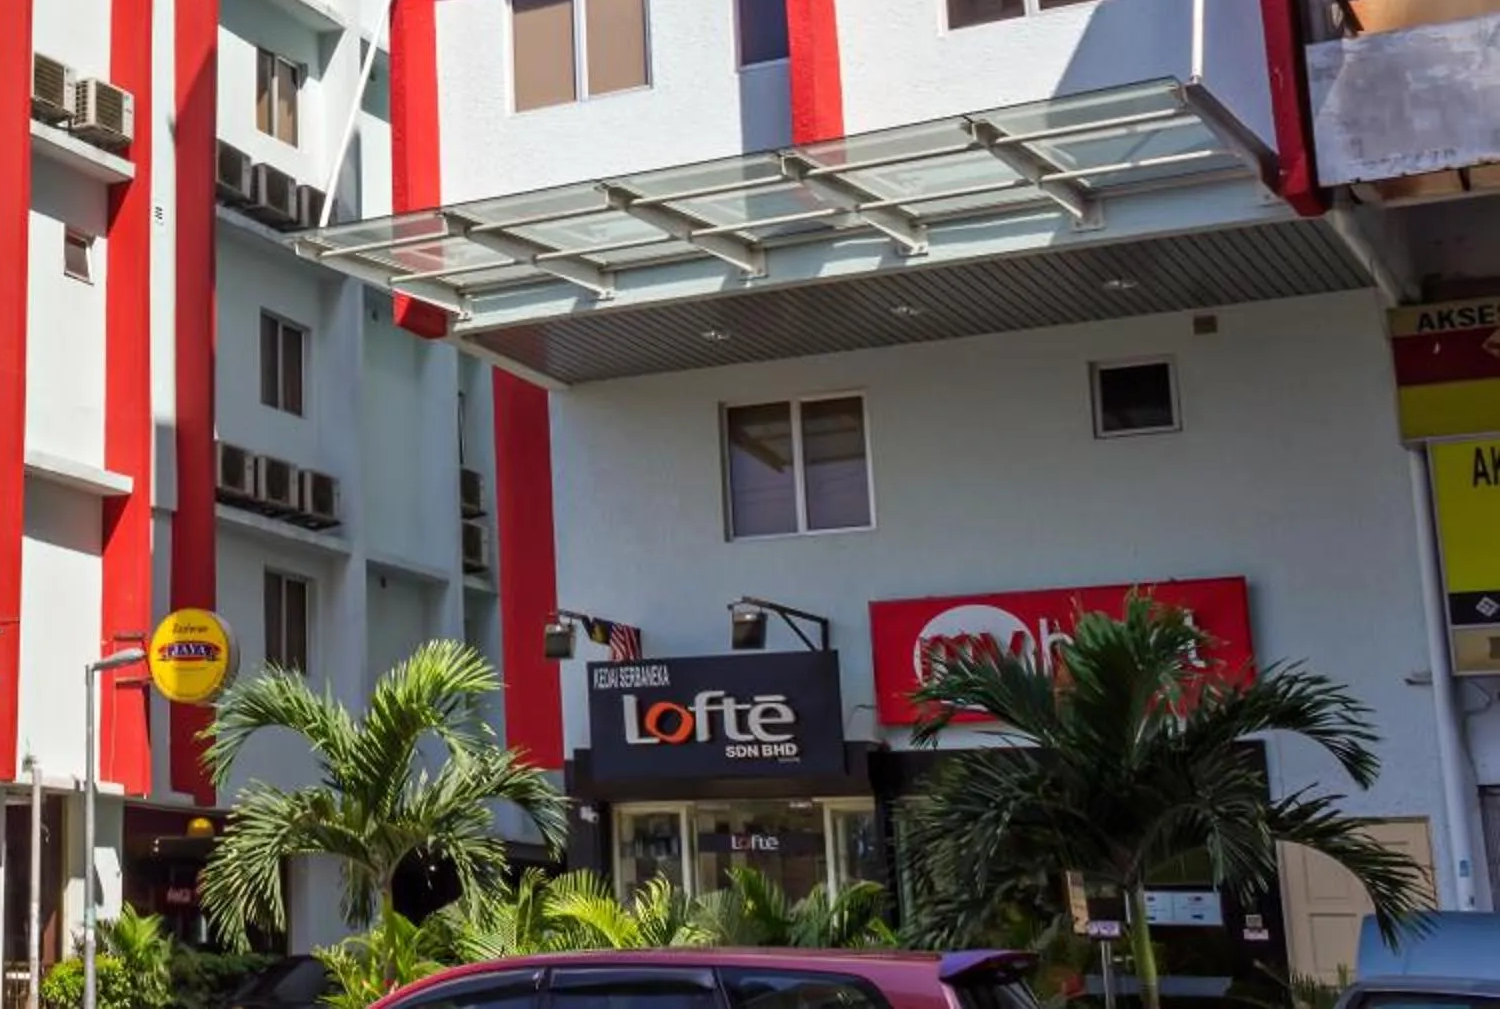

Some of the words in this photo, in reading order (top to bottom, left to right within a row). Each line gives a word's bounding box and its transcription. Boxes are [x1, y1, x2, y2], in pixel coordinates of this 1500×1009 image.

[1418, 304, 1500, 332] AKSE
[593, 667, 619, 689] KEDAI
[726, 745, 759, 759] SDN
[761, 742, 798, 757] BHD
